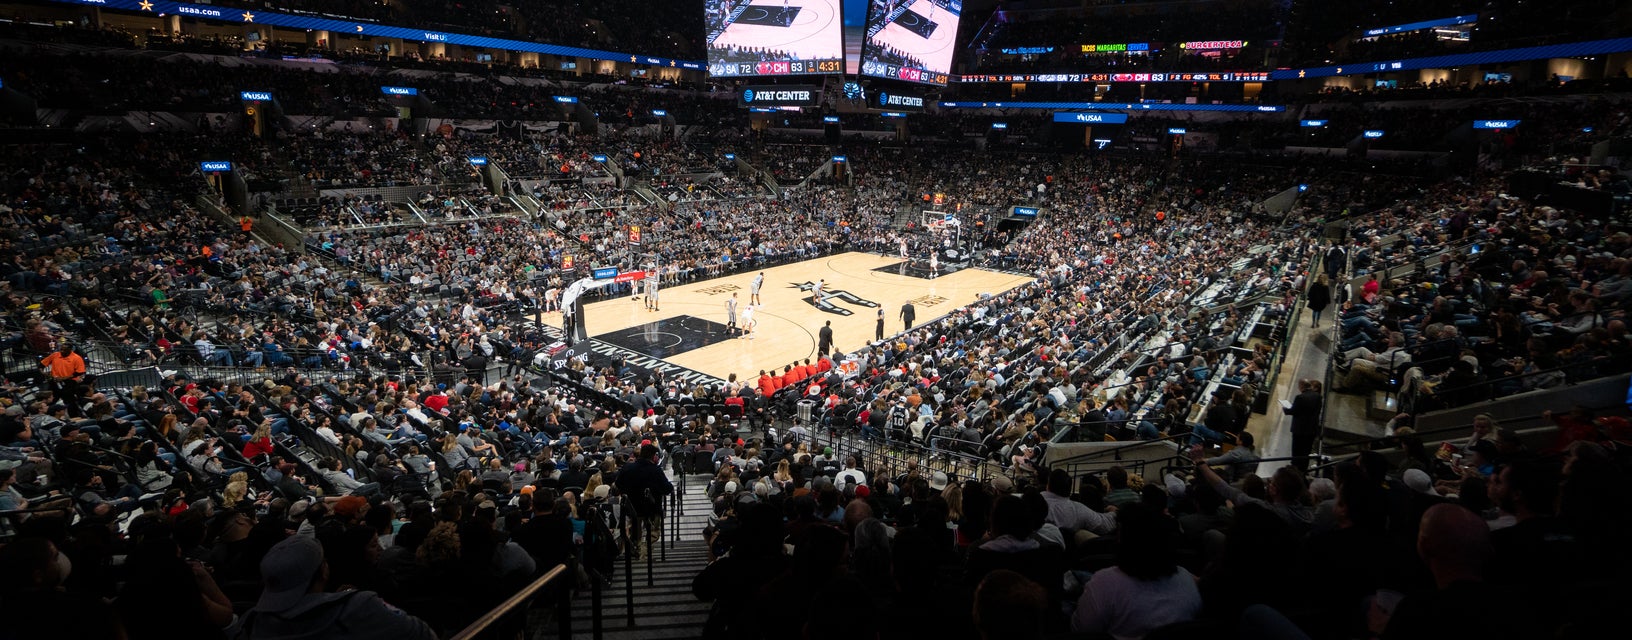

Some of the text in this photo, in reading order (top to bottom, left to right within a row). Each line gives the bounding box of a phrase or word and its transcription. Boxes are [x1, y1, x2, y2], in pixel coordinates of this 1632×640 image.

[179, 6, 220, 16] usaa.com
[741, 64, 751, 73] 72
[774, 63, 788, 73] CHI
[791, 63, 802, 72] 63
[819, 61, 840, 71] 4:31
[876, 65, 885, 74] SA
[888, 67, 896, 76] 72
[910, 70, 919, 79] CHI
[921, 72, 928, 81] 63
[936, 74, 948, 84] 4:31
[755, 91, 810, 100] AT&T CENTER
[888, 95, 922, 106] AT&T CENTER
[554, 352, 588, 370] SPANG
[894, 417, 904, 426] 10
